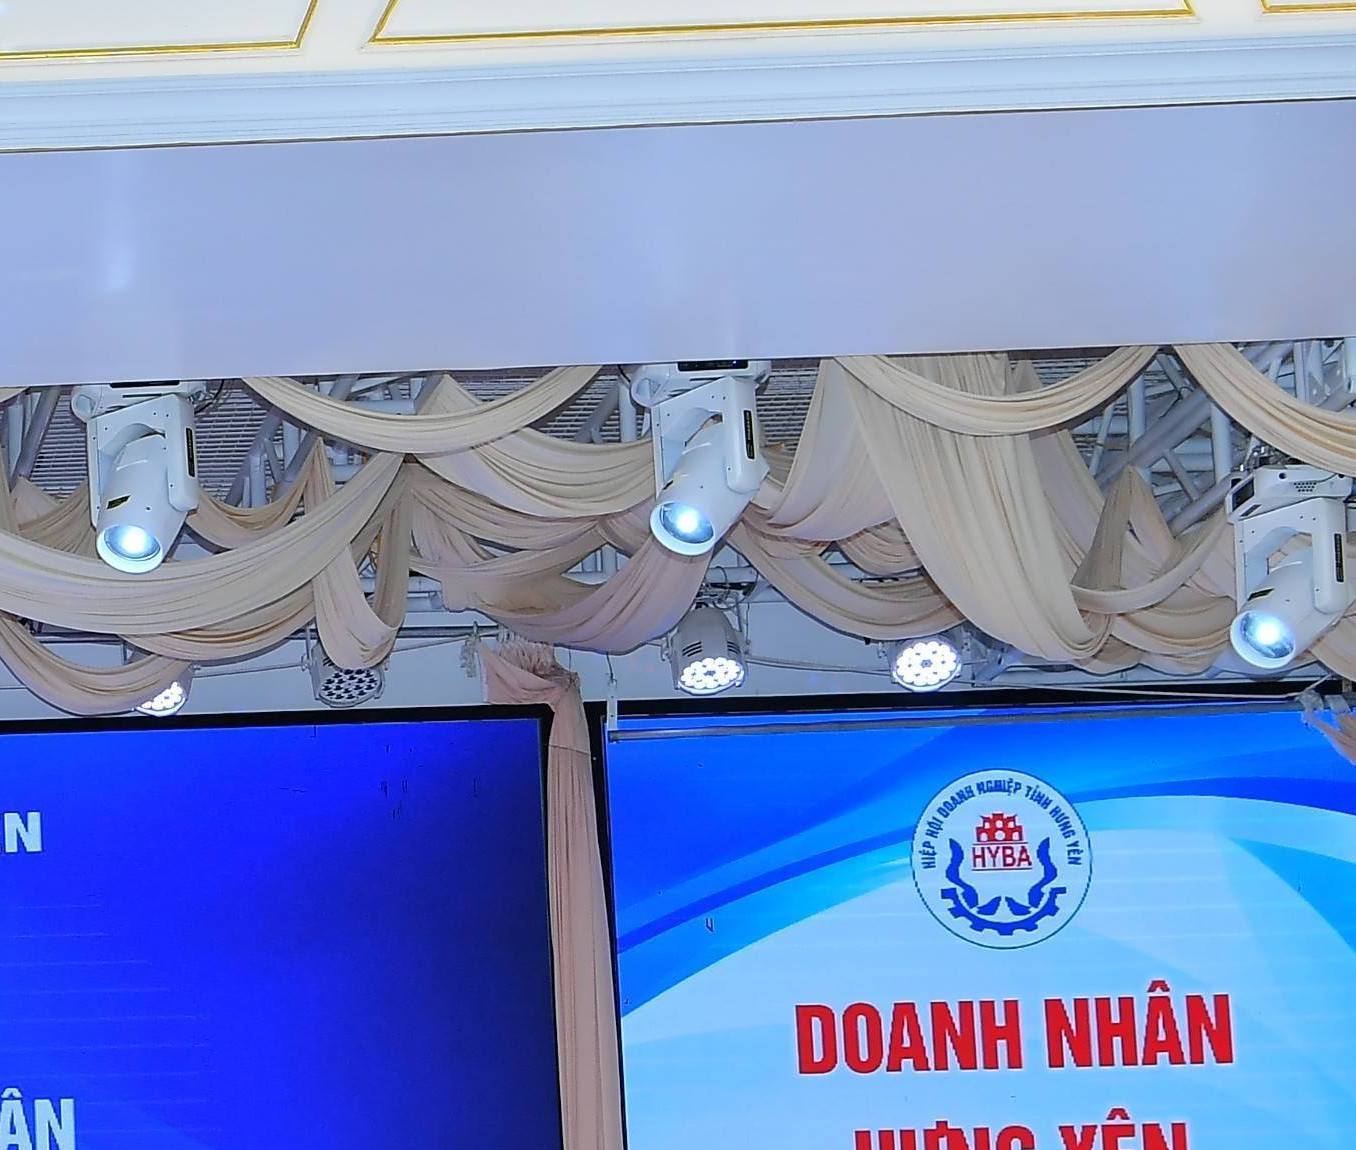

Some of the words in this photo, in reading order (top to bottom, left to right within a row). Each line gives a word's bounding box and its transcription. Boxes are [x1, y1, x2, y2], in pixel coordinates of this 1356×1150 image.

[972, 846, 1033, 868] HYBA
[1066, 840, 1084, 866] YÊN
[795, 999, 1023, 1075] DOANH
[1045, 979, 1234, 1070] NHÂN
